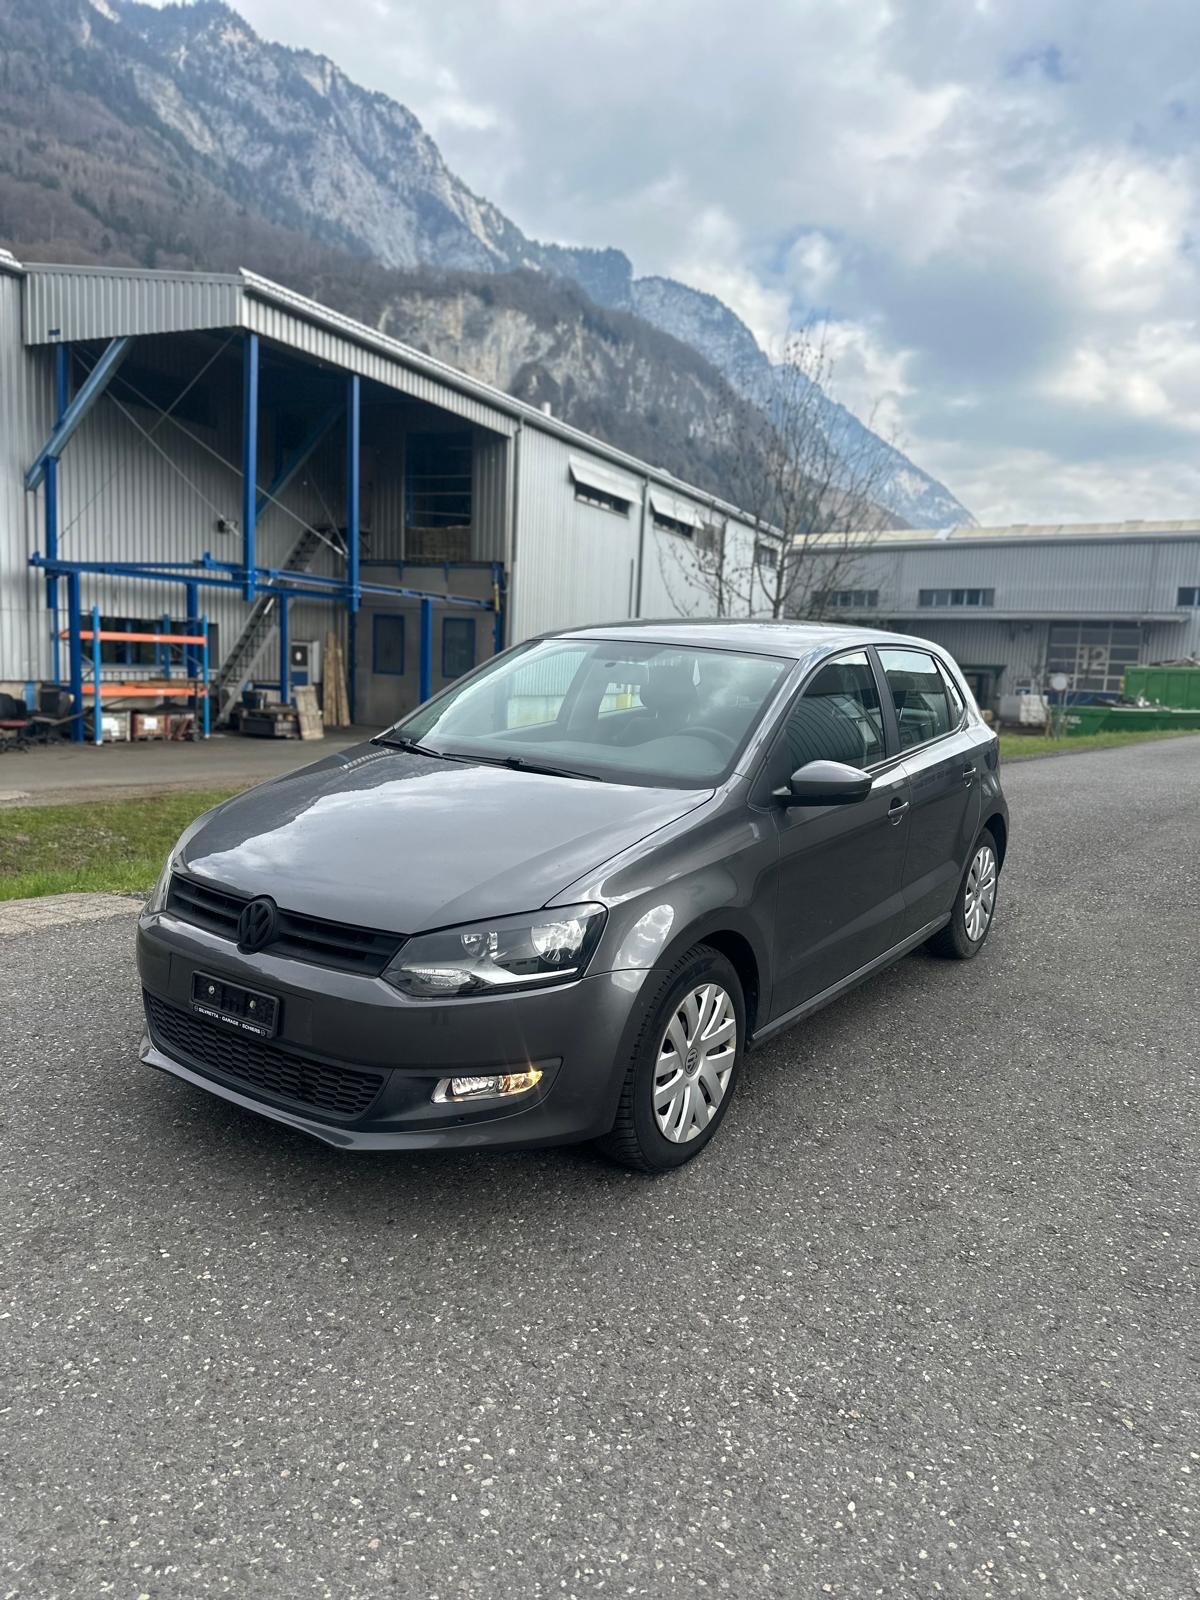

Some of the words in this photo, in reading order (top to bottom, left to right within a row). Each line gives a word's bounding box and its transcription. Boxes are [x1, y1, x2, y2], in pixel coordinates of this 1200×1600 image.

[1079, 647, 1107, 670] 12
[238, 900, 274, 950] VW
[198, 1007, 219, 1019] SILVRETTA
[221, 1016, 239, 1027] GARAGE
